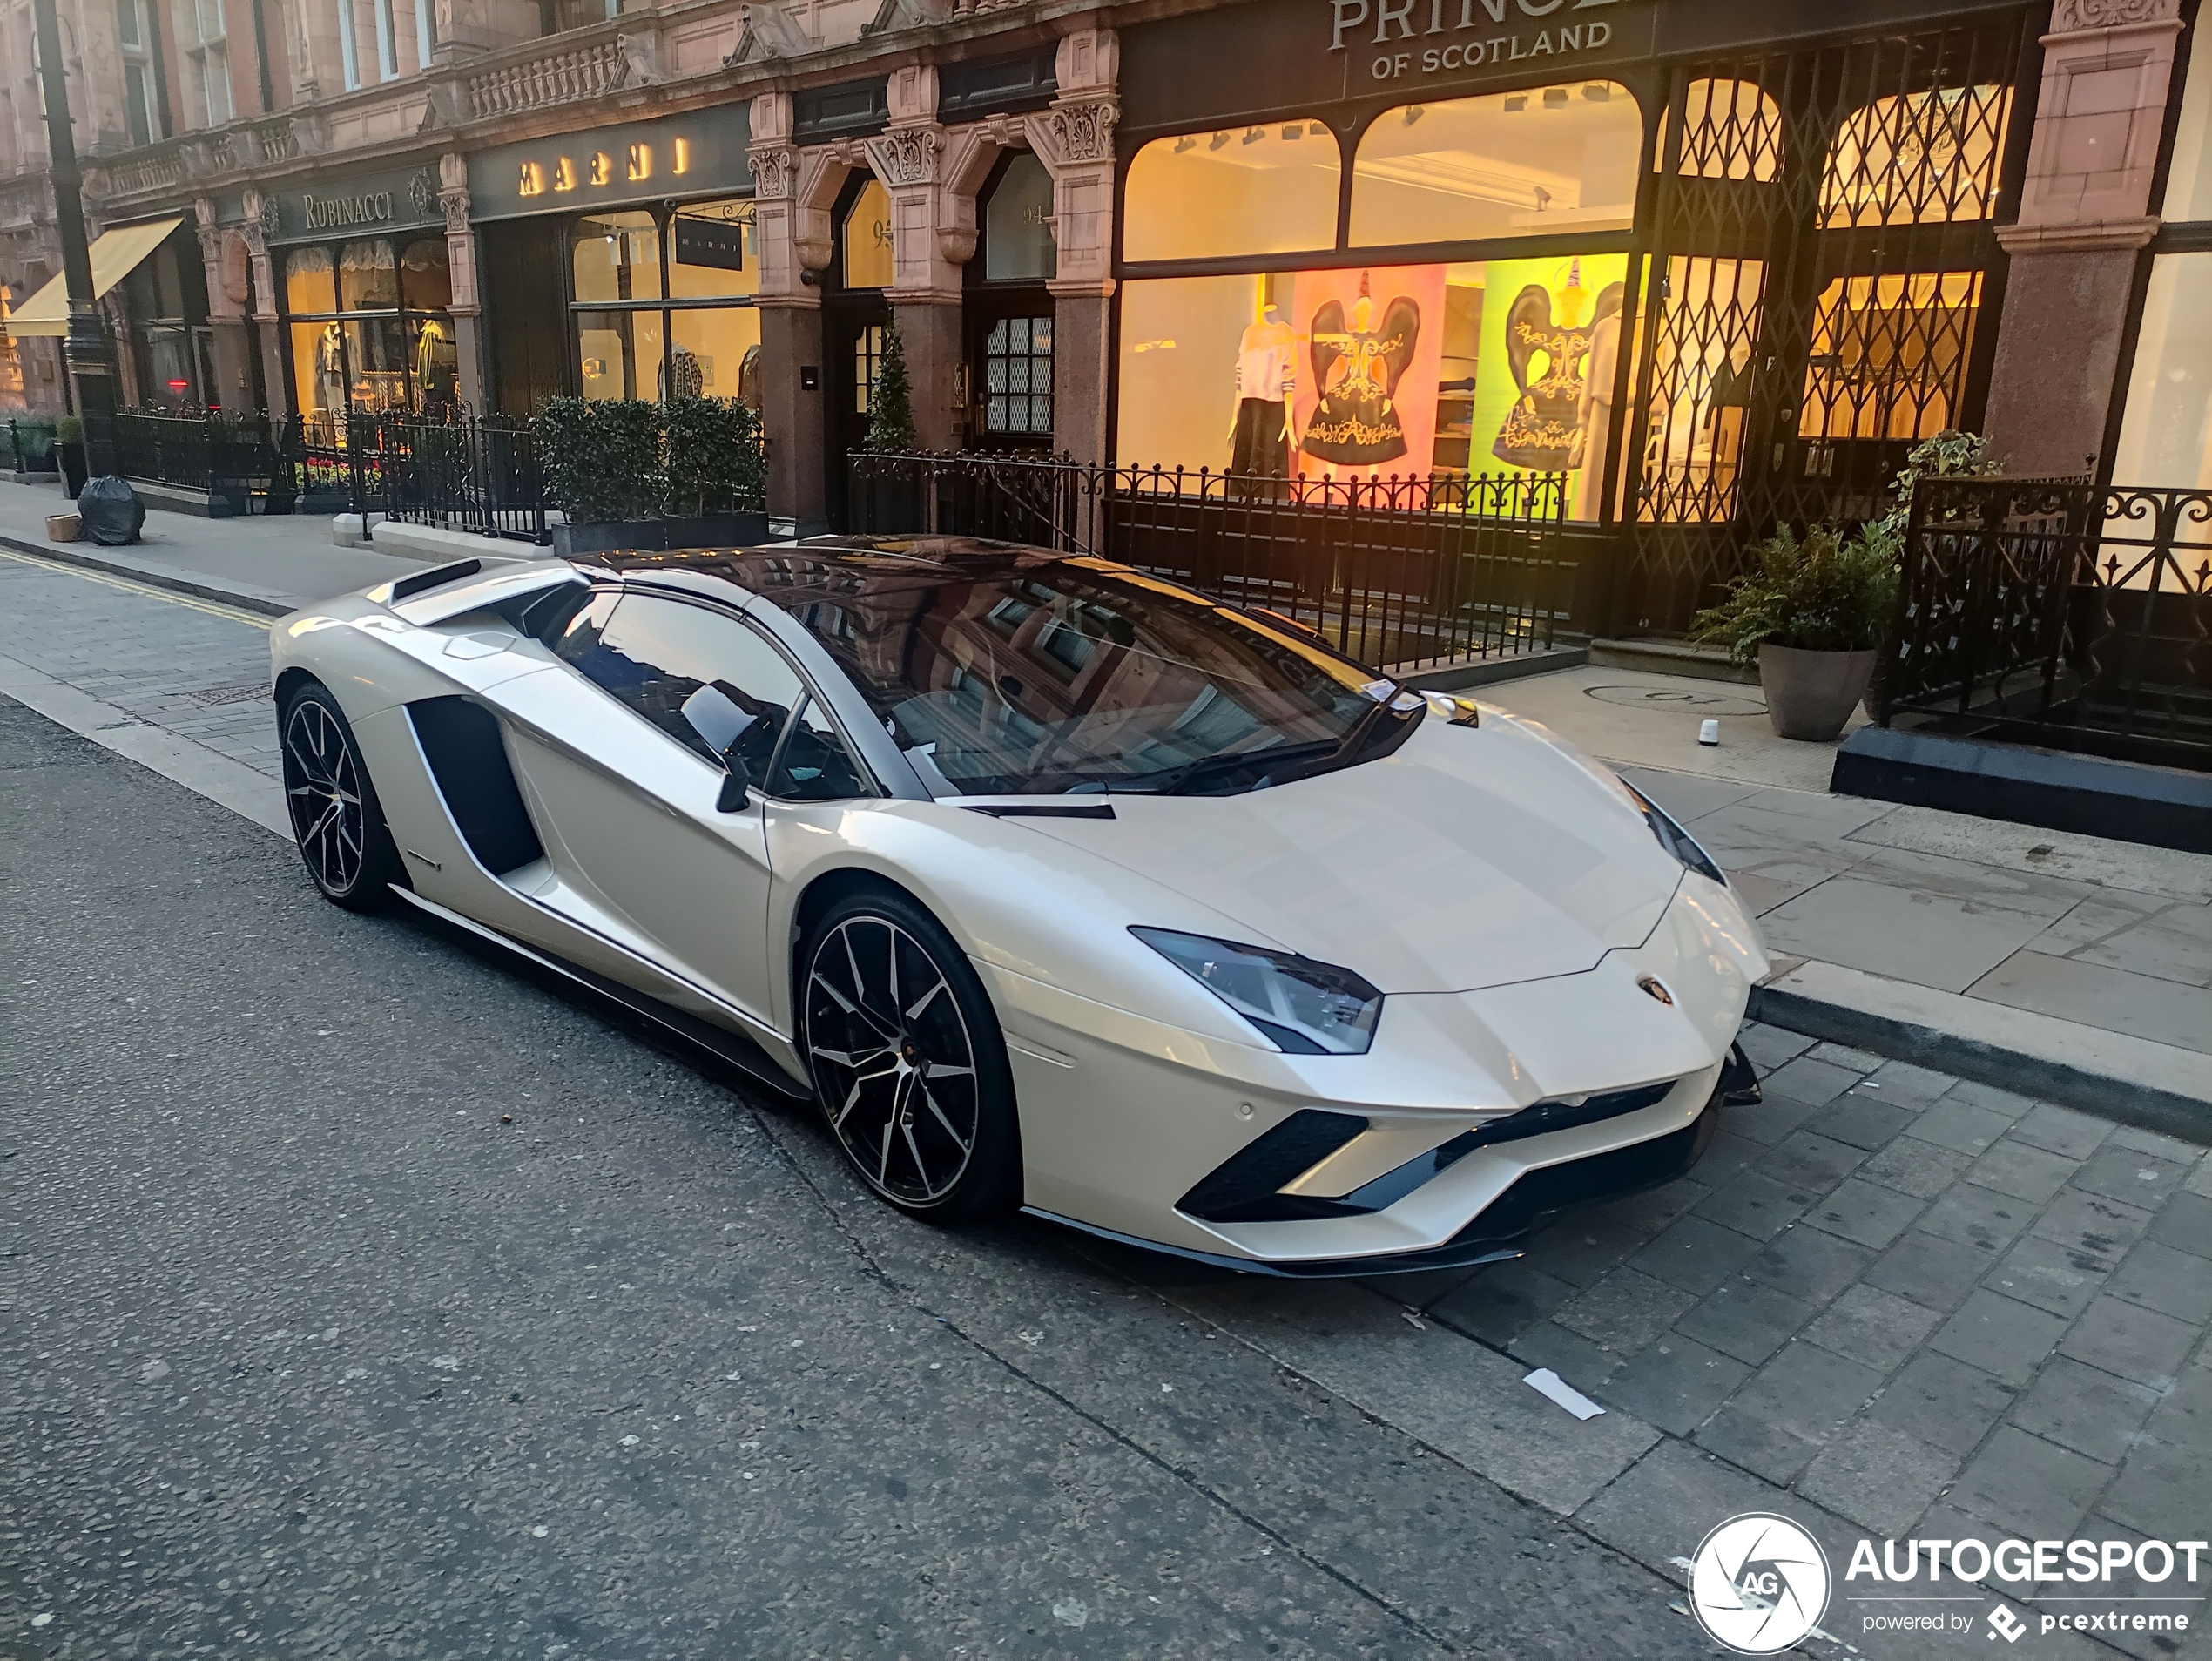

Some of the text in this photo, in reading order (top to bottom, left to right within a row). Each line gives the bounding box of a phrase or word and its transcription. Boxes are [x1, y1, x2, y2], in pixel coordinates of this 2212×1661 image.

[1372, 22, 1611, 80] OF SCOTLAND
[518, 137, 685, 196] MARNI
[303, 192, 393, 229] RUBINACCI
[1022, 205, 1043, 226] 94
